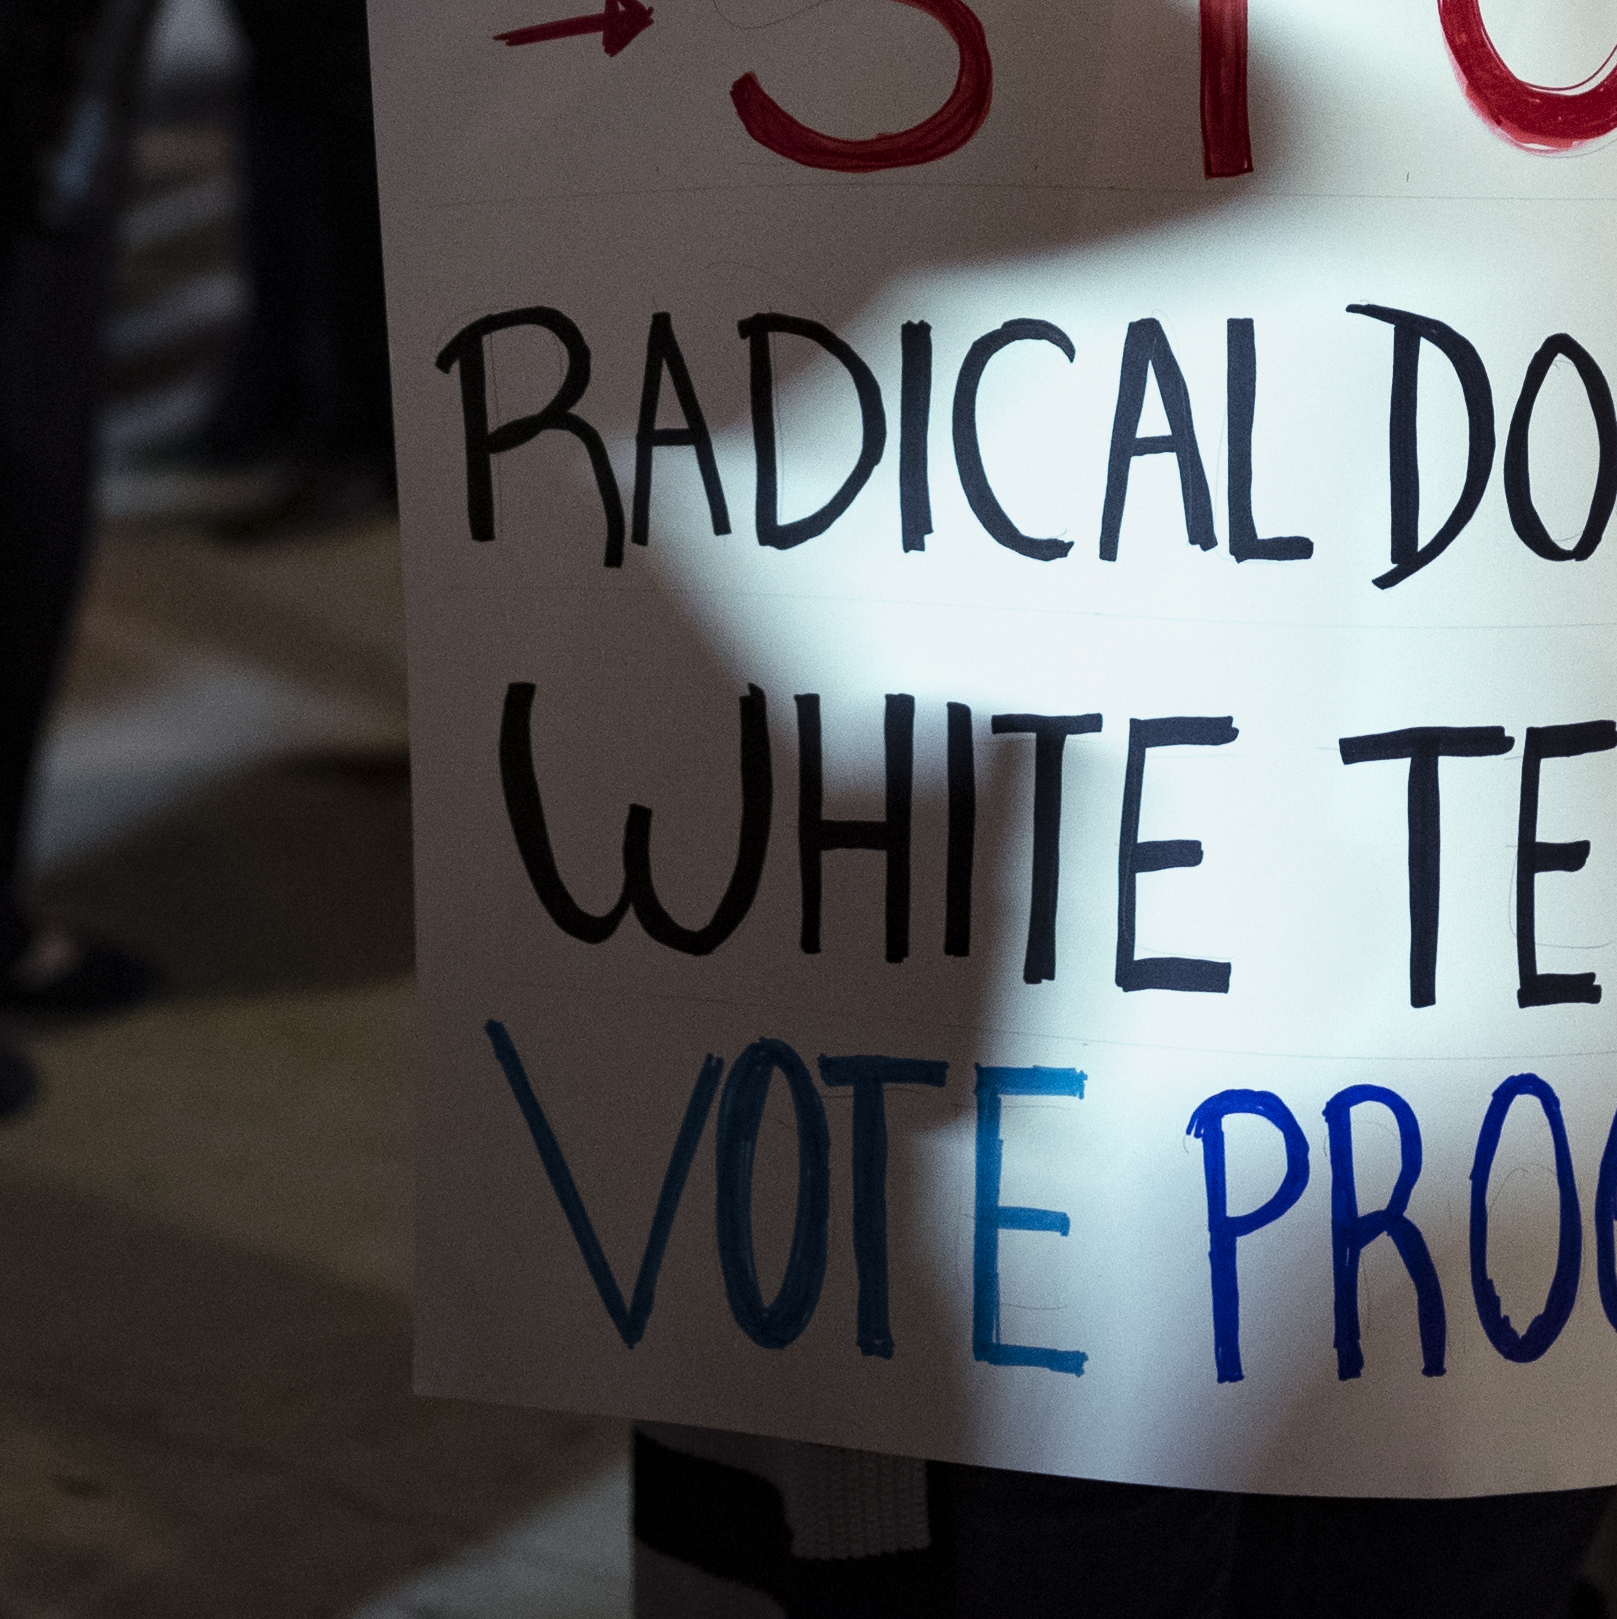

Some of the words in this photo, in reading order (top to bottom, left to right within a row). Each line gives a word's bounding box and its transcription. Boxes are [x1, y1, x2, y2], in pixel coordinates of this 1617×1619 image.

[434, 305, 1314, 568] RADICAL
[496, 682, 1239, 994] WHITE
[484, 1019, 1089, 1376] VOTE
